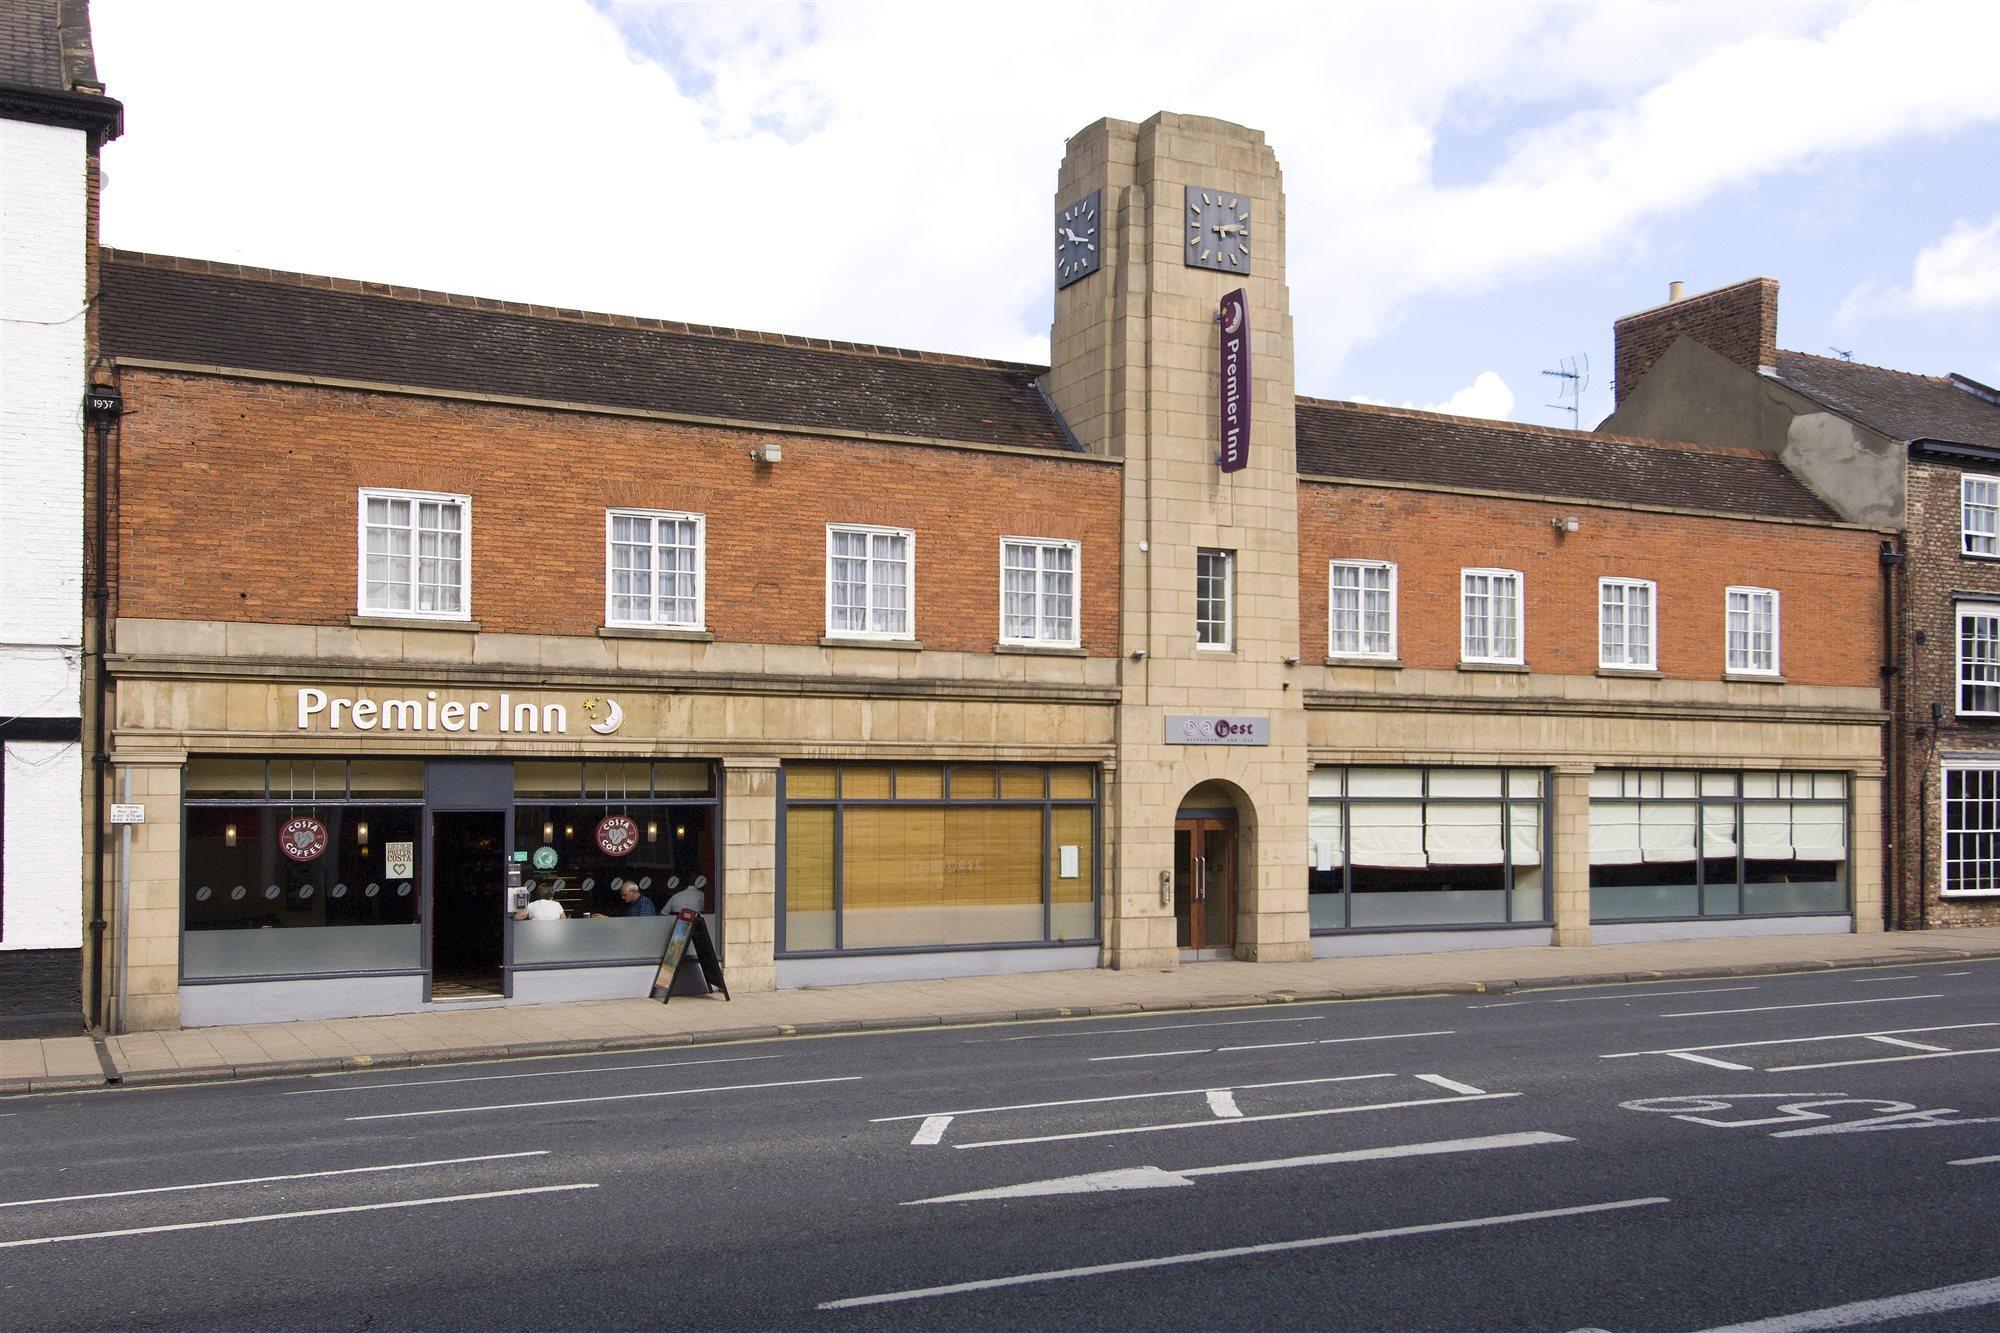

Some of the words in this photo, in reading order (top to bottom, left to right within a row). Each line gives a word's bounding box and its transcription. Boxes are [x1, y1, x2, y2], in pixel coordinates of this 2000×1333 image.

[1227, 338, 1240, 424] Premier
[94, 399, 114, 409] 1937
[1227, 427, 1240, 462] Inn
[297, 688, 489, 731] Premier
[500, 693, 567, 733] Inn
[289, 820, 318, 832] COSTA
[603, 819, 629, 830] COSTA
[286, 842, 322, 856] COFFEE
[602, 839, 633, 851] COFFEE
